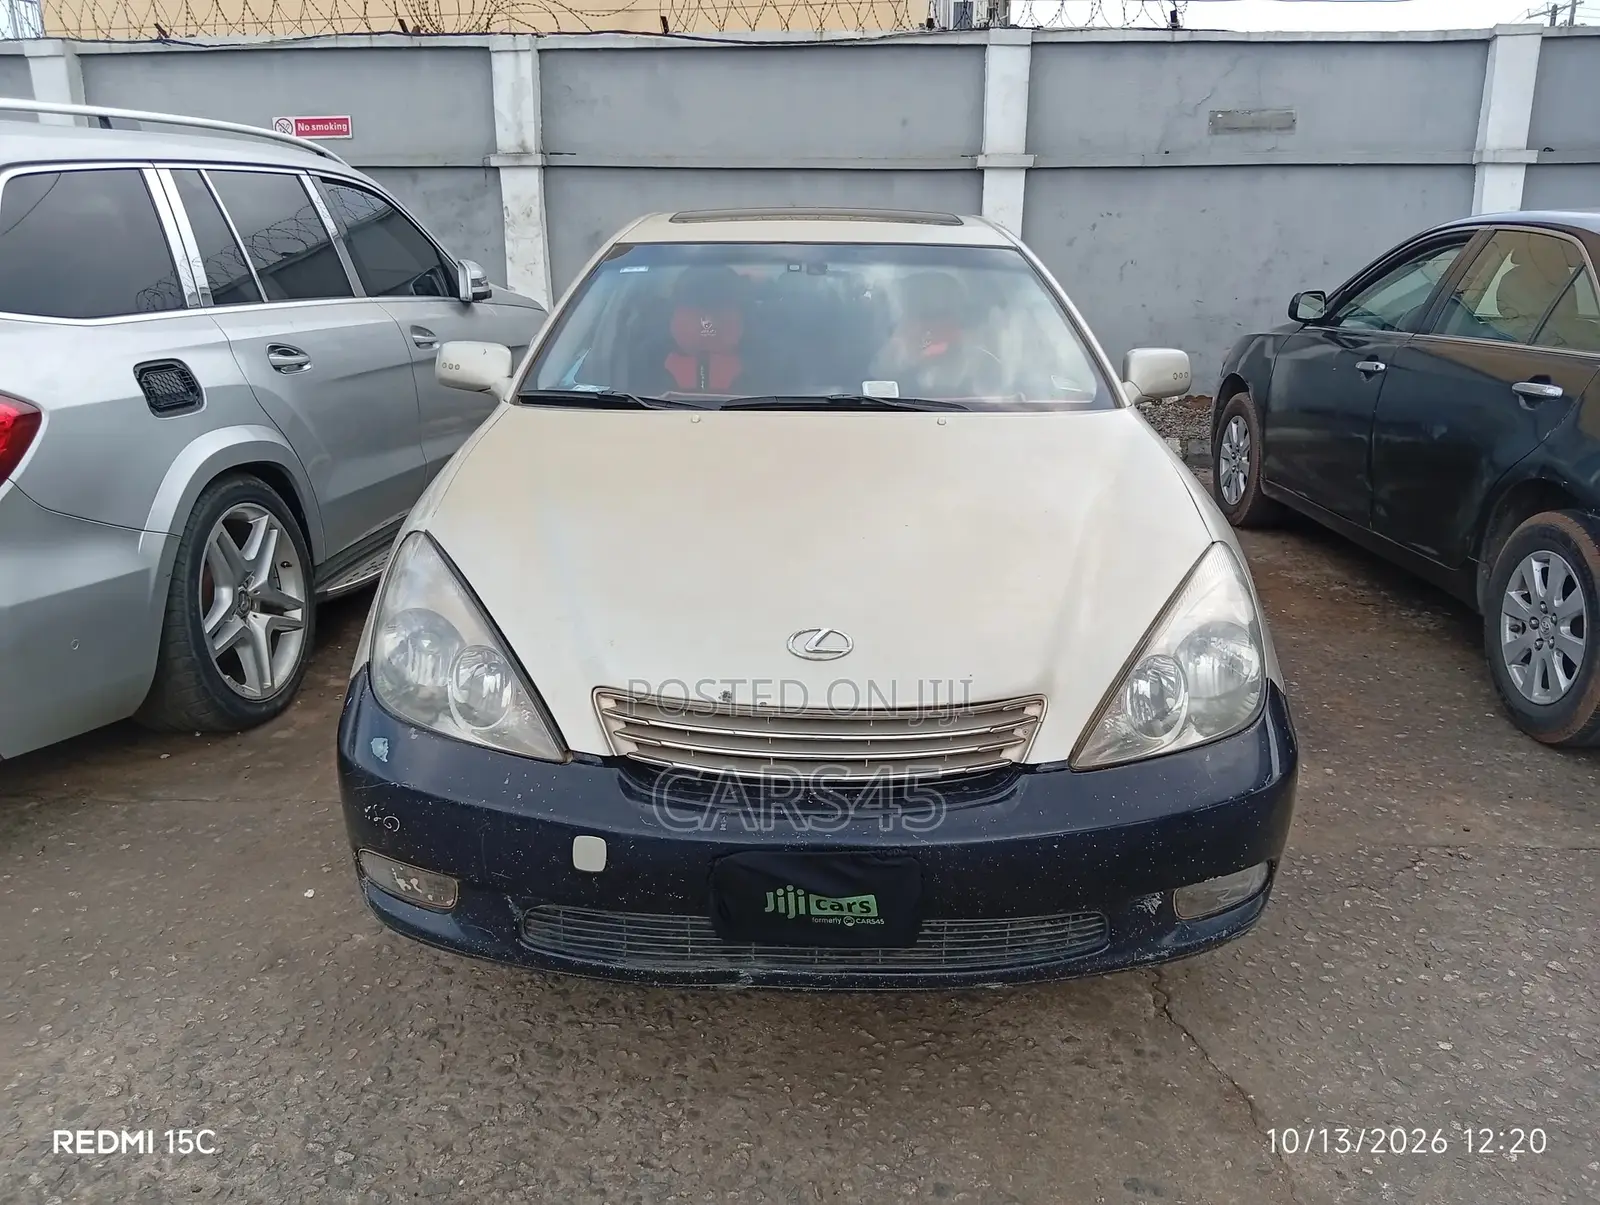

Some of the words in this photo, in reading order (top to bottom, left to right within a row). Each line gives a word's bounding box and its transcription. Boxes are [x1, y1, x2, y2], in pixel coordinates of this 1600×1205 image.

[297, 122, 310, 132] No
[311, 122, 348, 132] smoking
[815, 899, 872, 914] cars
[812, 917, 842, 925] formerly
